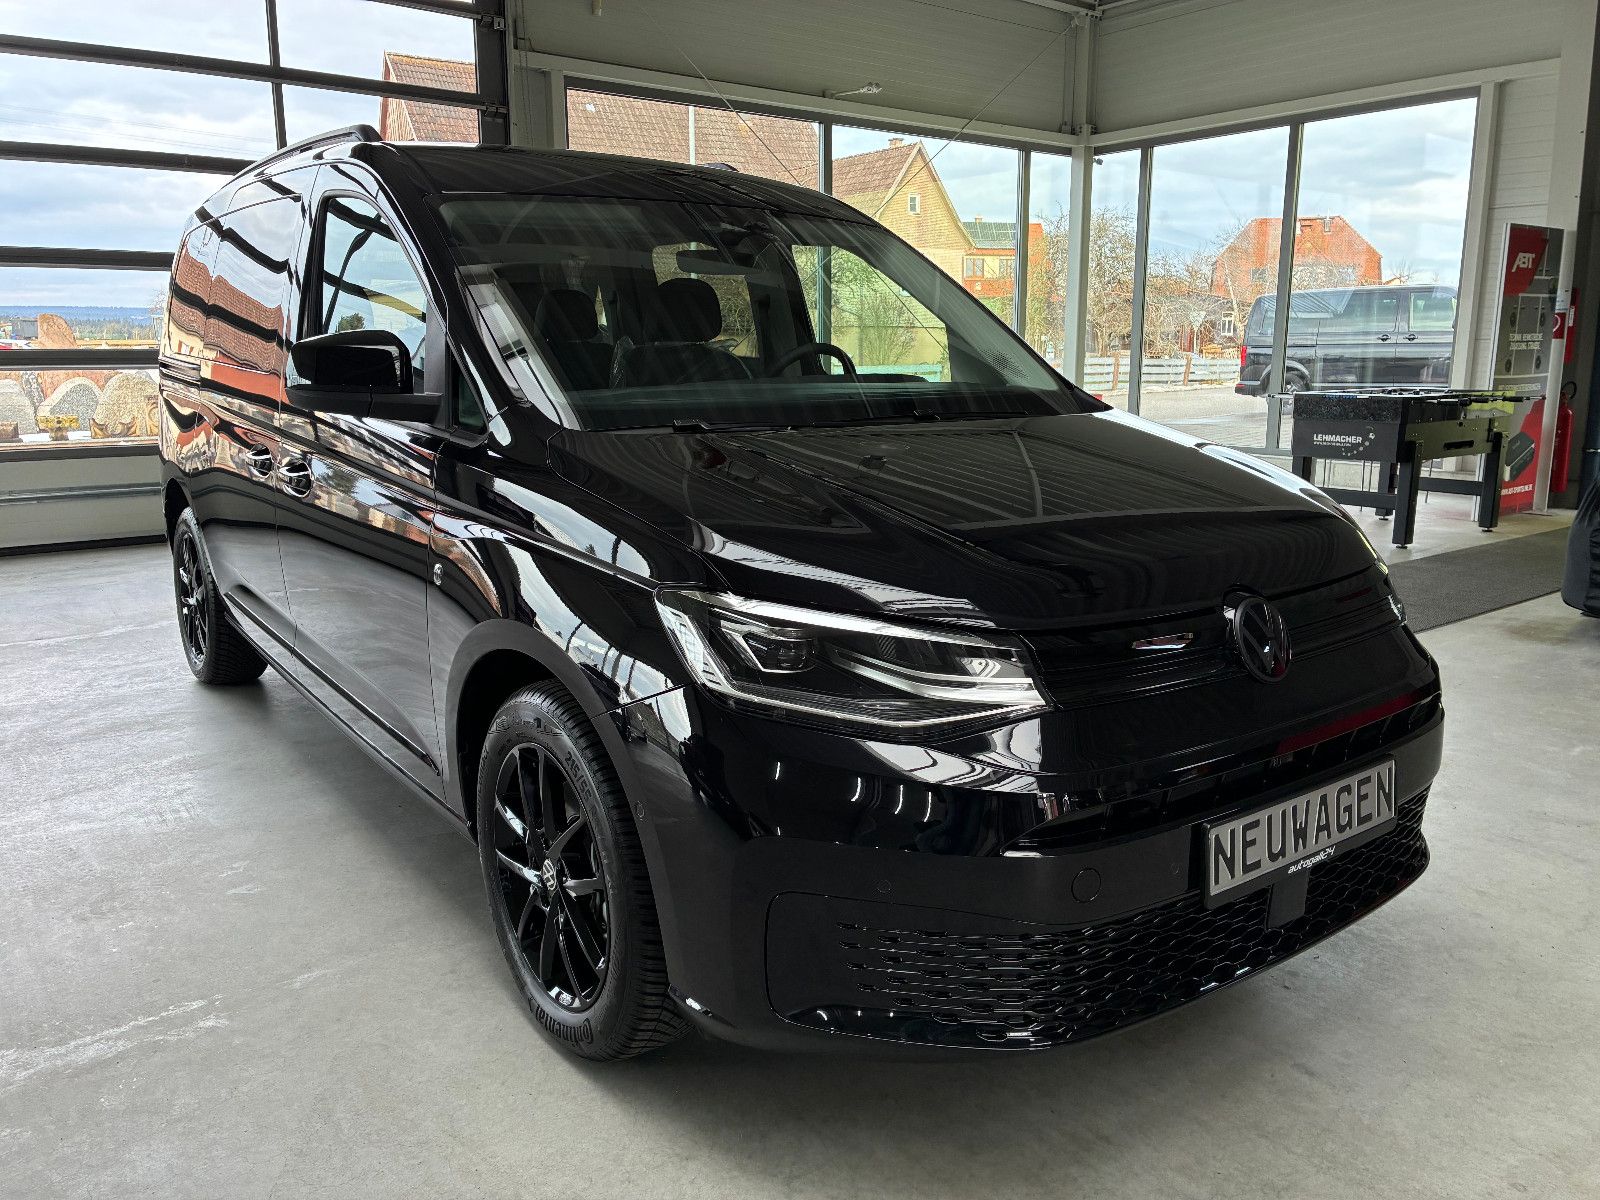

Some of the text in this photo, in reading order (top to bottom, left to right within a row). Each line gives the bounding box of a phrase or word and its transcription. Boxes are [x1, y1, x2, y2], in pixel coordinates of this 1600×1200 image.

[1511, 252, 1535, 272] ABT
[1313, 433, 1363, 444] LEHMACHER
[1212, 767, 1392, 886] NEUWAGEN
[534, 1004, 595, 1047] Continental
